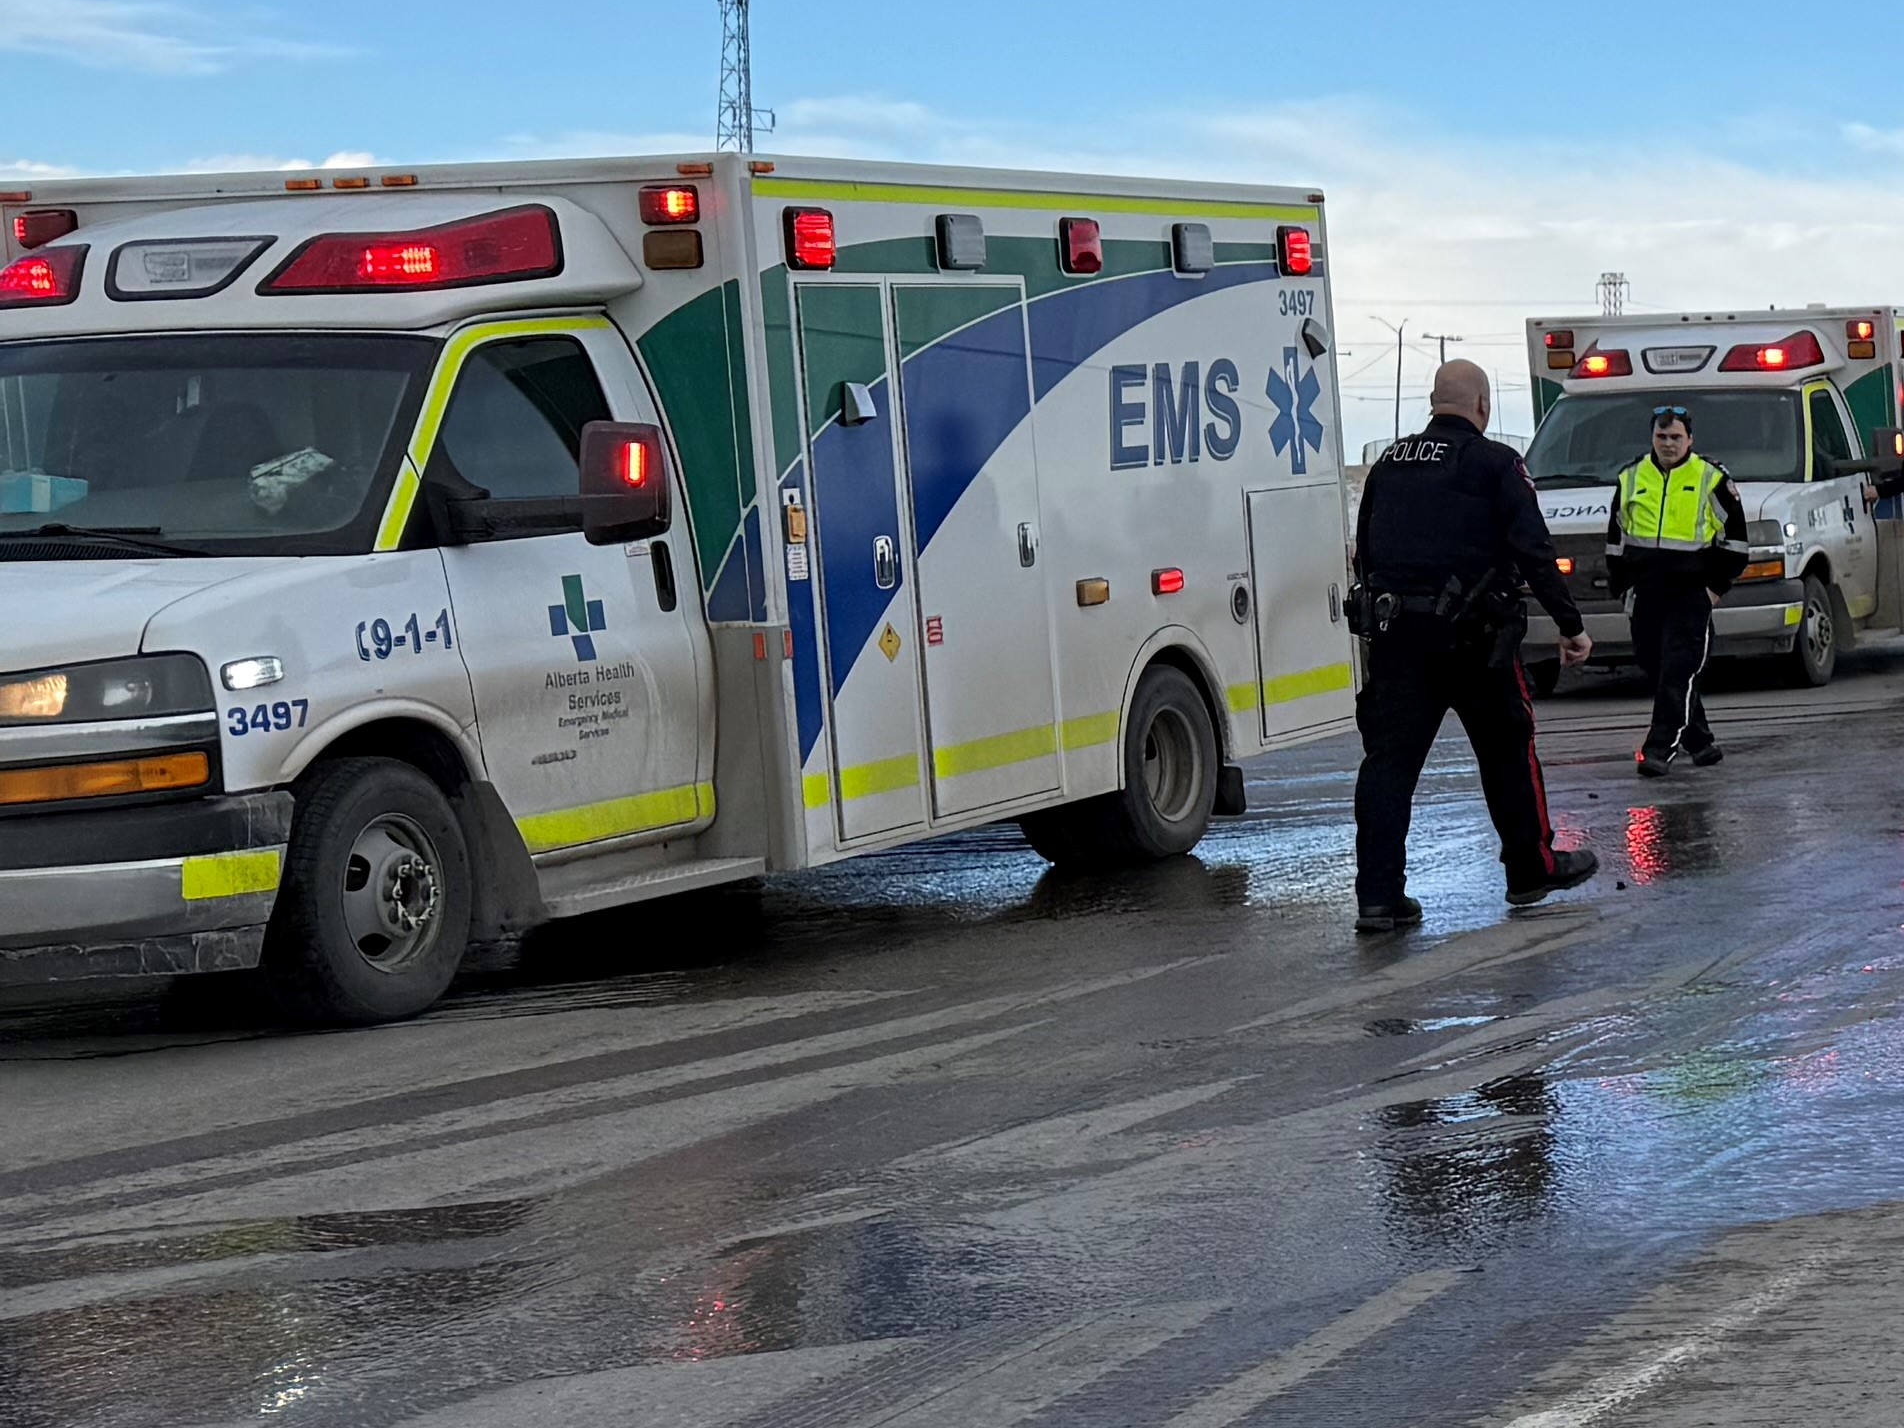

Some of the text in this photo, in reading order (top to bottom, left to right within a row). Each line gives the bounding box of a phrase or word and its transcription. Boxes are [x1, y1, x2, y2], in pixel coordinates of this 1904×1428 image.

[1278, 289, 1315, 316] 3497
[1109, 357, 1242, 471] EMS
[1381, 440, 1449, 463] POLICE
[544, 662, 635, 689] Alberta Health
[568, 690, 621, 710] Services
[226, 698, 309, 737] 3497
